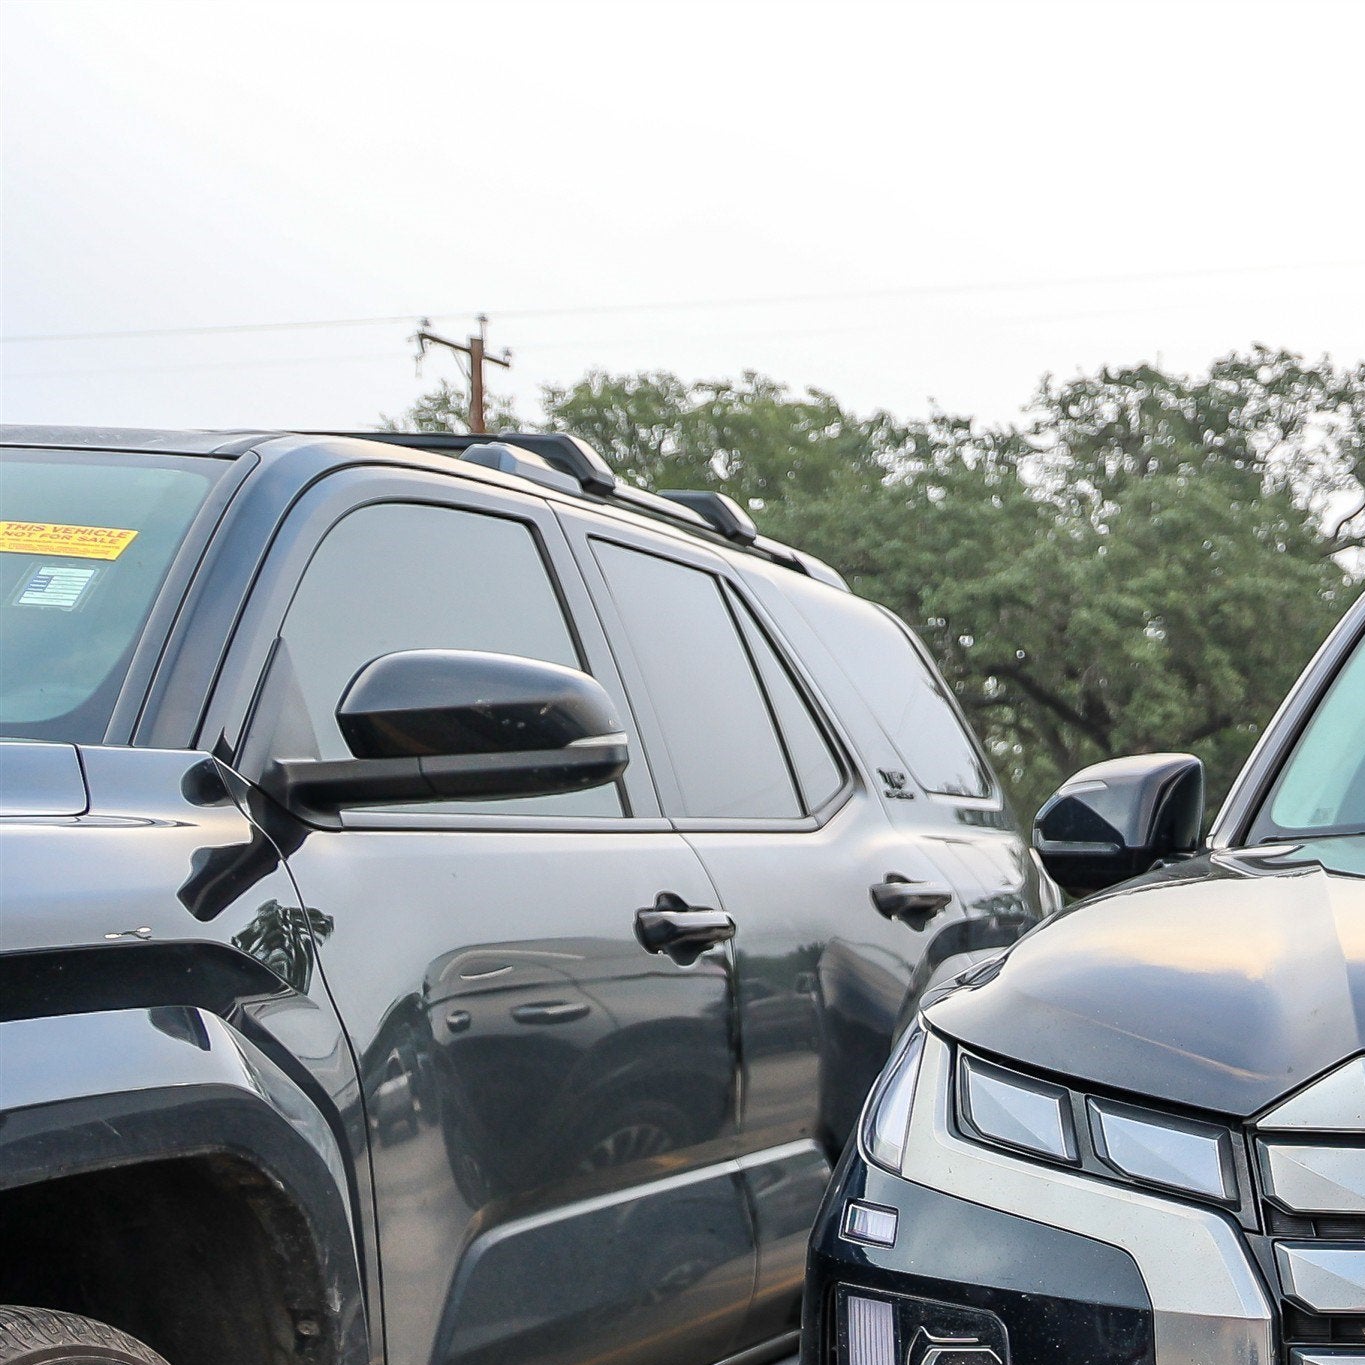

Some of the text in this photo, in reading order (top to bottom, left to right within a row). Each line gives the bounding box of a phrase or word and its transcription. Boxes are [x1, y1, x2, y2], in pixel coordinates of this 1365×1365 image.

[5, 523, 132, 539] THIS VEHICLE
[39, 533, 73, 541] FOR
[77, 536, 120, 544] SALE
